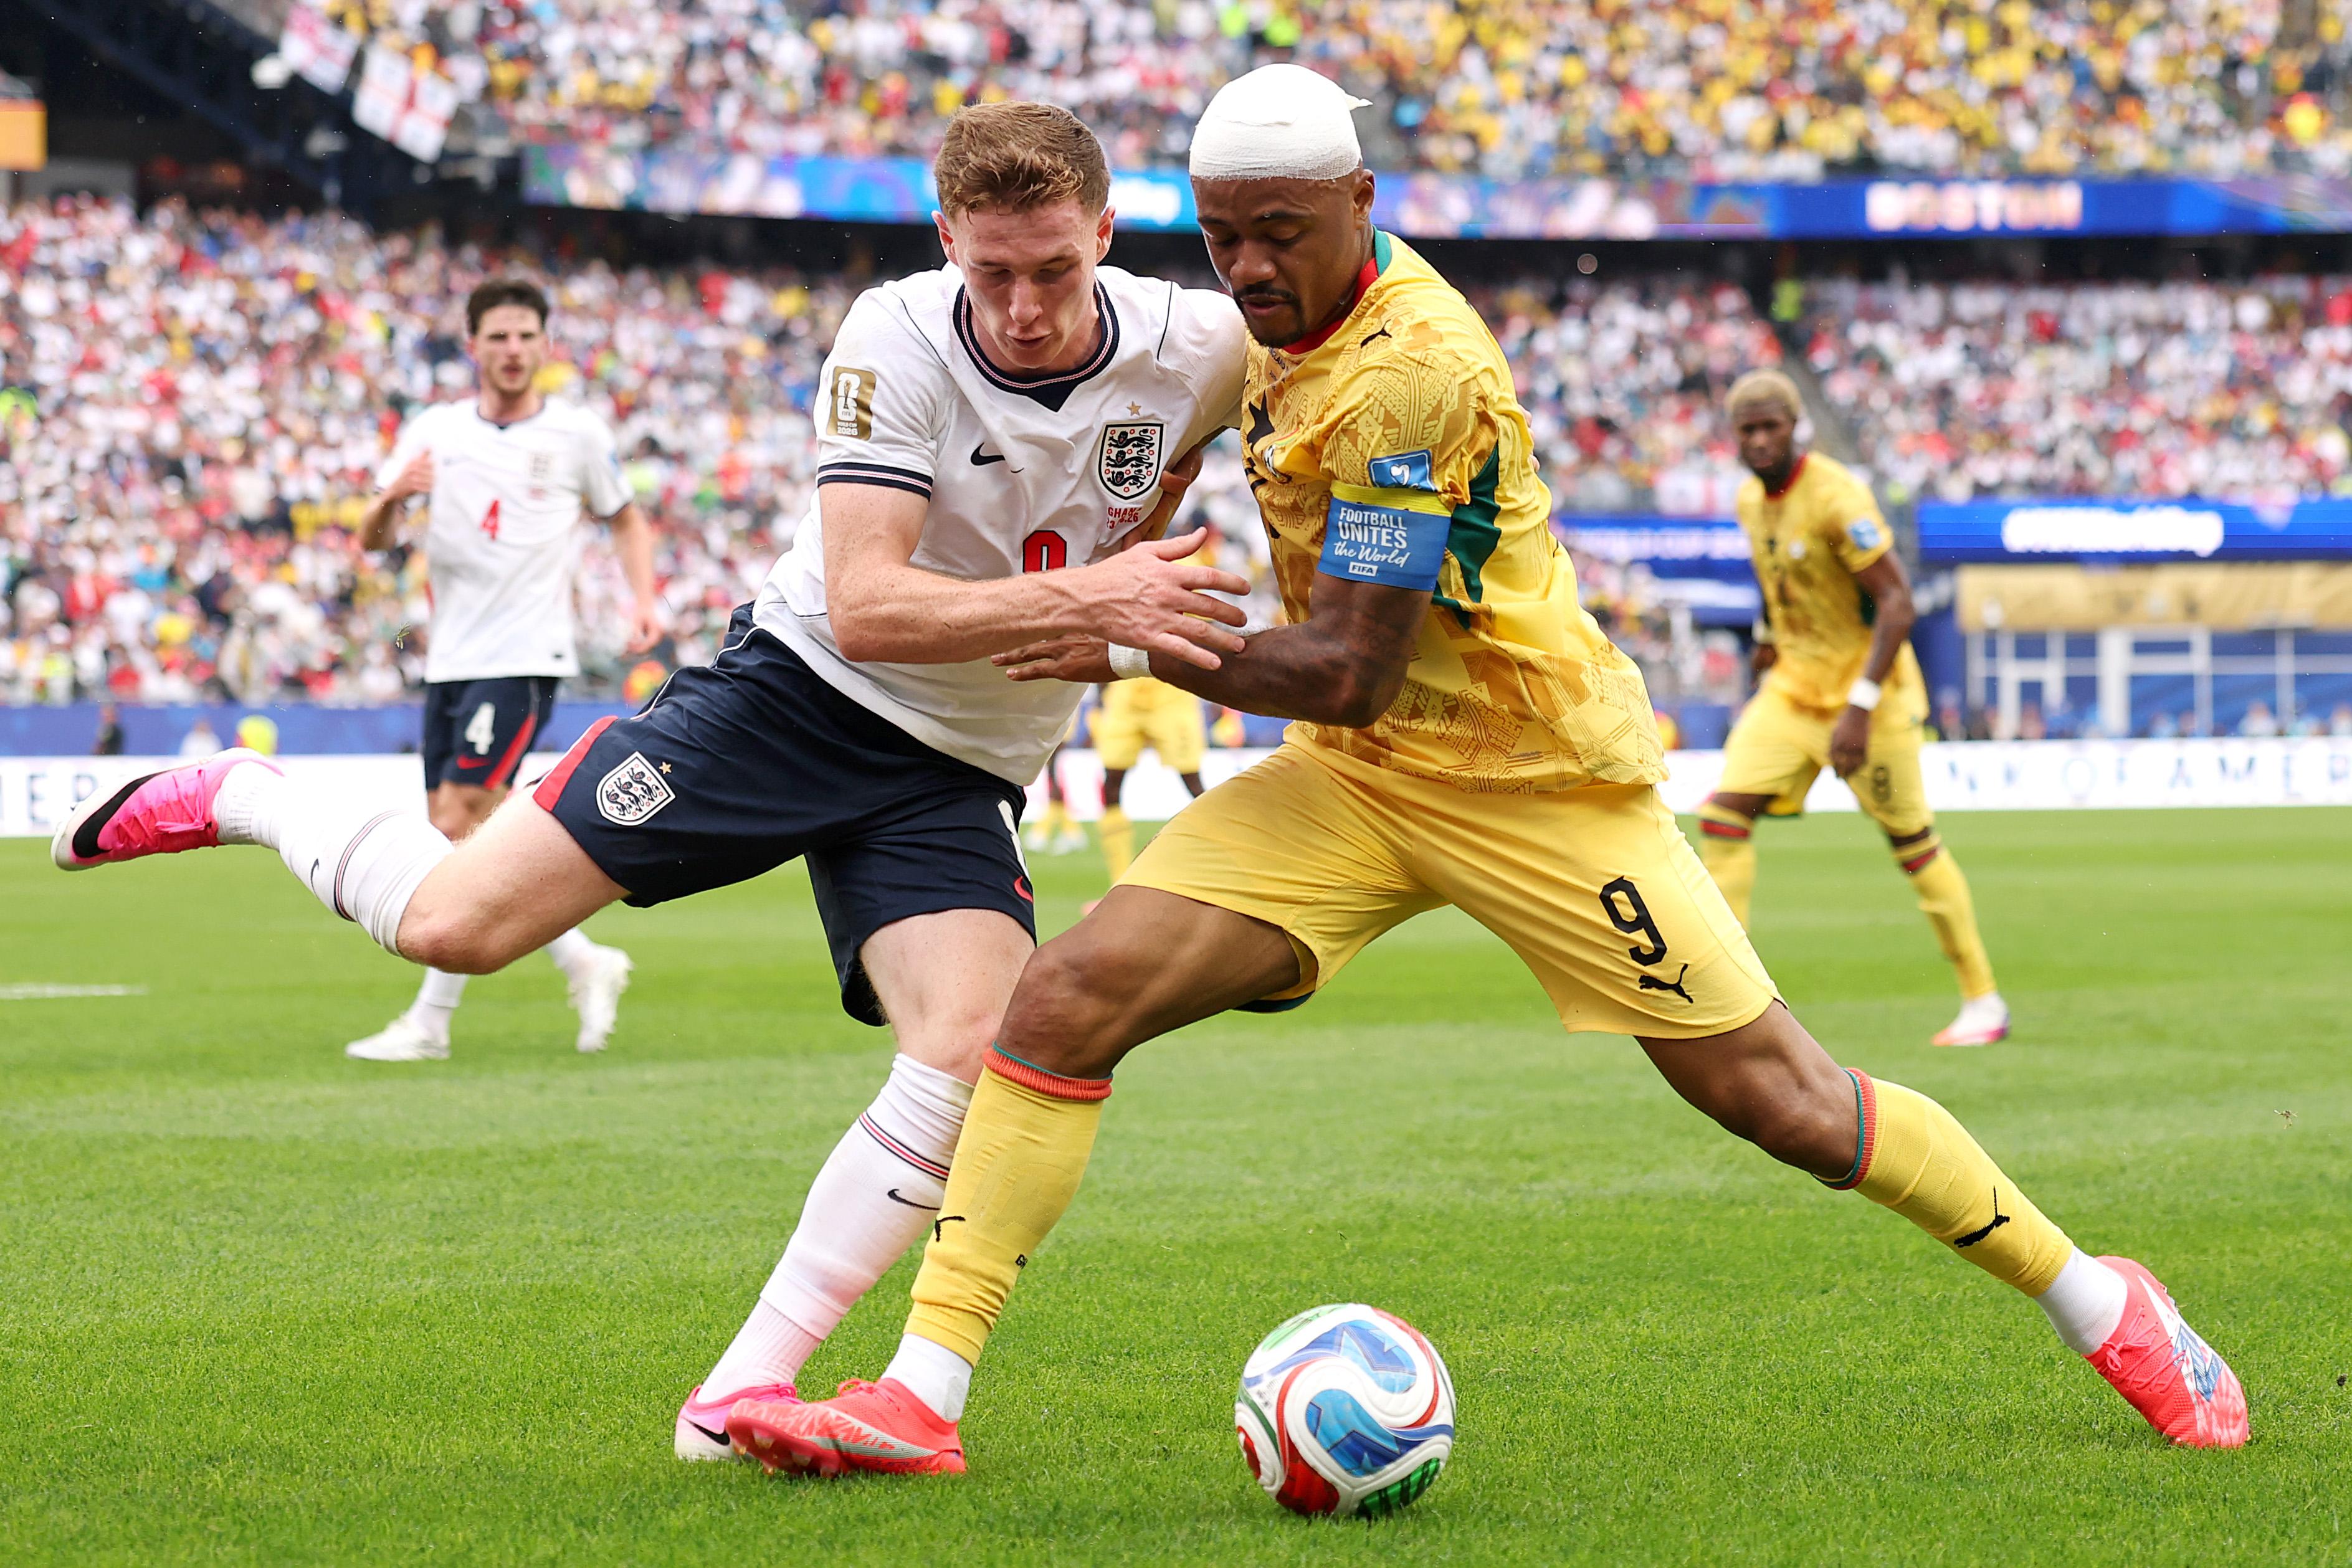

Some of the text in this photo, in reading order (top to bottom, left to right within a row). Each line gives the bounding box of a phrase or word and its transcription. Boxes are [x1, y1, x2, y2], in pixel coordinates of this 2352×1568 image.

[837, 427, 858, 435] 2026
[480, 498, 499, 541] 4
[1340, 507, 1407, 530] FOOTBALL
[1338, 521, 1407, 549] UNITES
[1334, 541, 1411, 568] the World
[1351, 564, 1374, 574] FIFA
[465, 701, 495, 756] 4
[1599, 875, 1668, 967] 9
